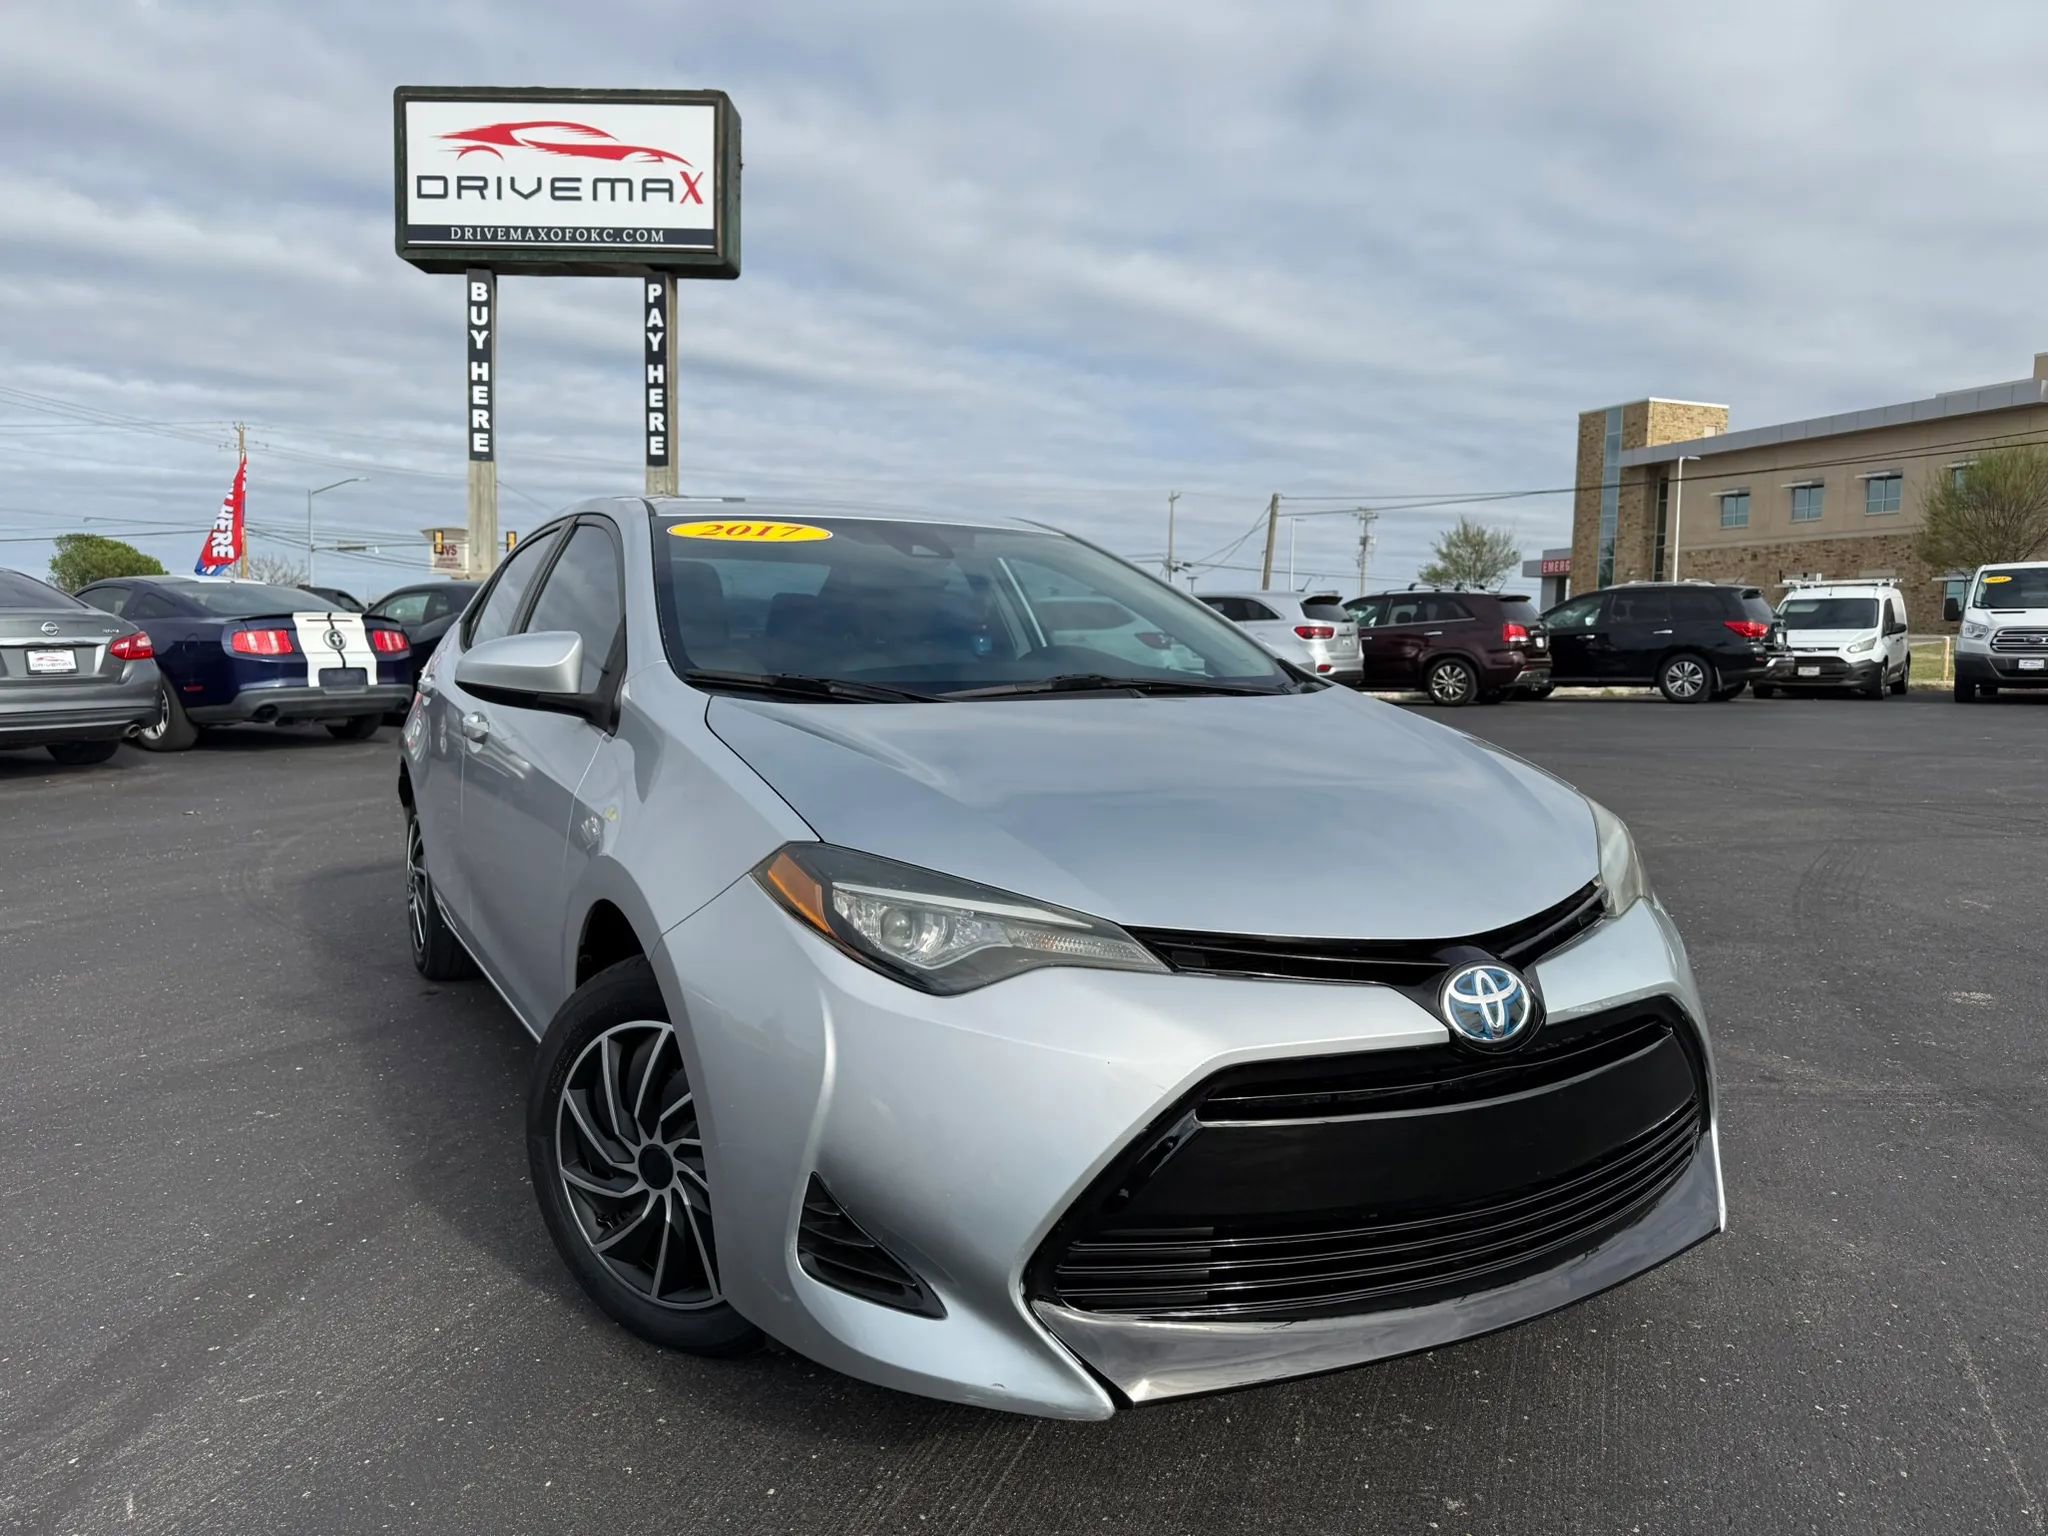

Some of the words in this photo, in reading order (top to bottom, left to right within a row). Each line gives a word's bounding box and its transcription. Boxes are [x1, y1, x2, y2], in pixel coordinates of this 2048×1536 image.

[450, 226, 665, 243] DRIVEMAXOFOKC.COM
[470, 281, 489, 350] BUY
[647, 283, 664, 352] PAY
[470, 361, 490, 453] HERE
[648, 364, 666, 456] HERE
[696, 524, 803, 538] 2017
